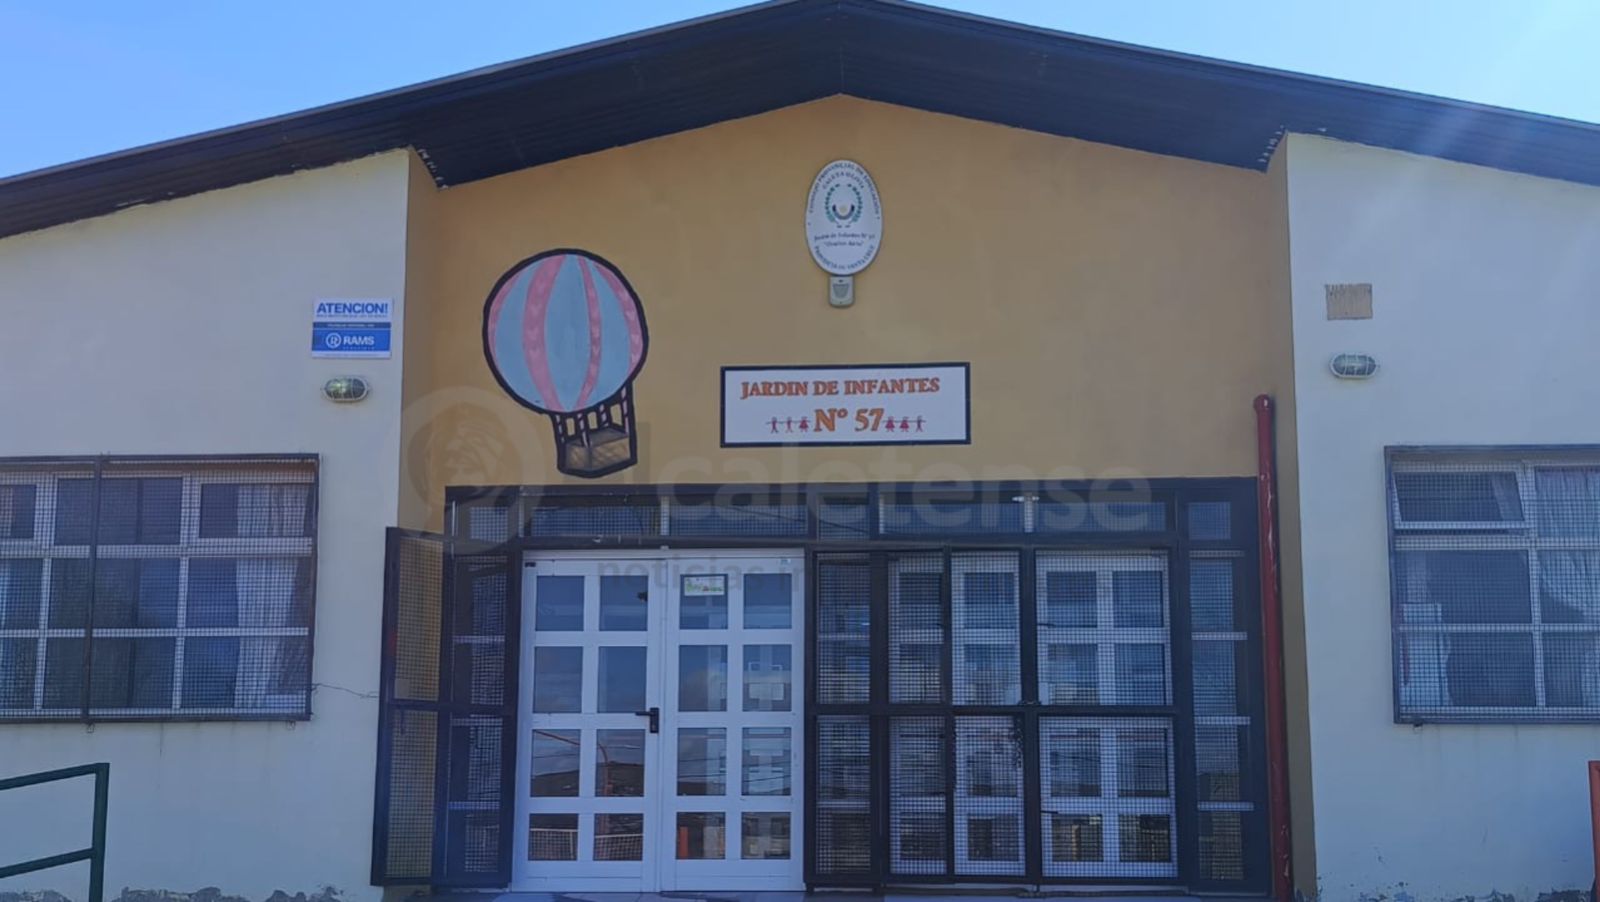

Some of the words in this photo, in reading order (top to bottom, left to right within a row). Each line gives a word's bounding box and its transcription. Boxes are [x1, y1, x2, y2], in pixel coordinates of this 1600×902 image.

[316, 301, 389, 314] ATENCION!
[343, 335, 376, 345] RAMS
[740, 380, 810, 400] JARDIN
[813, 380, 839, 396] DE
[844, 377, 941, 396] INFANTES
[813, 407, 849, 433] N°
[854, 407, 885, 433] 57
